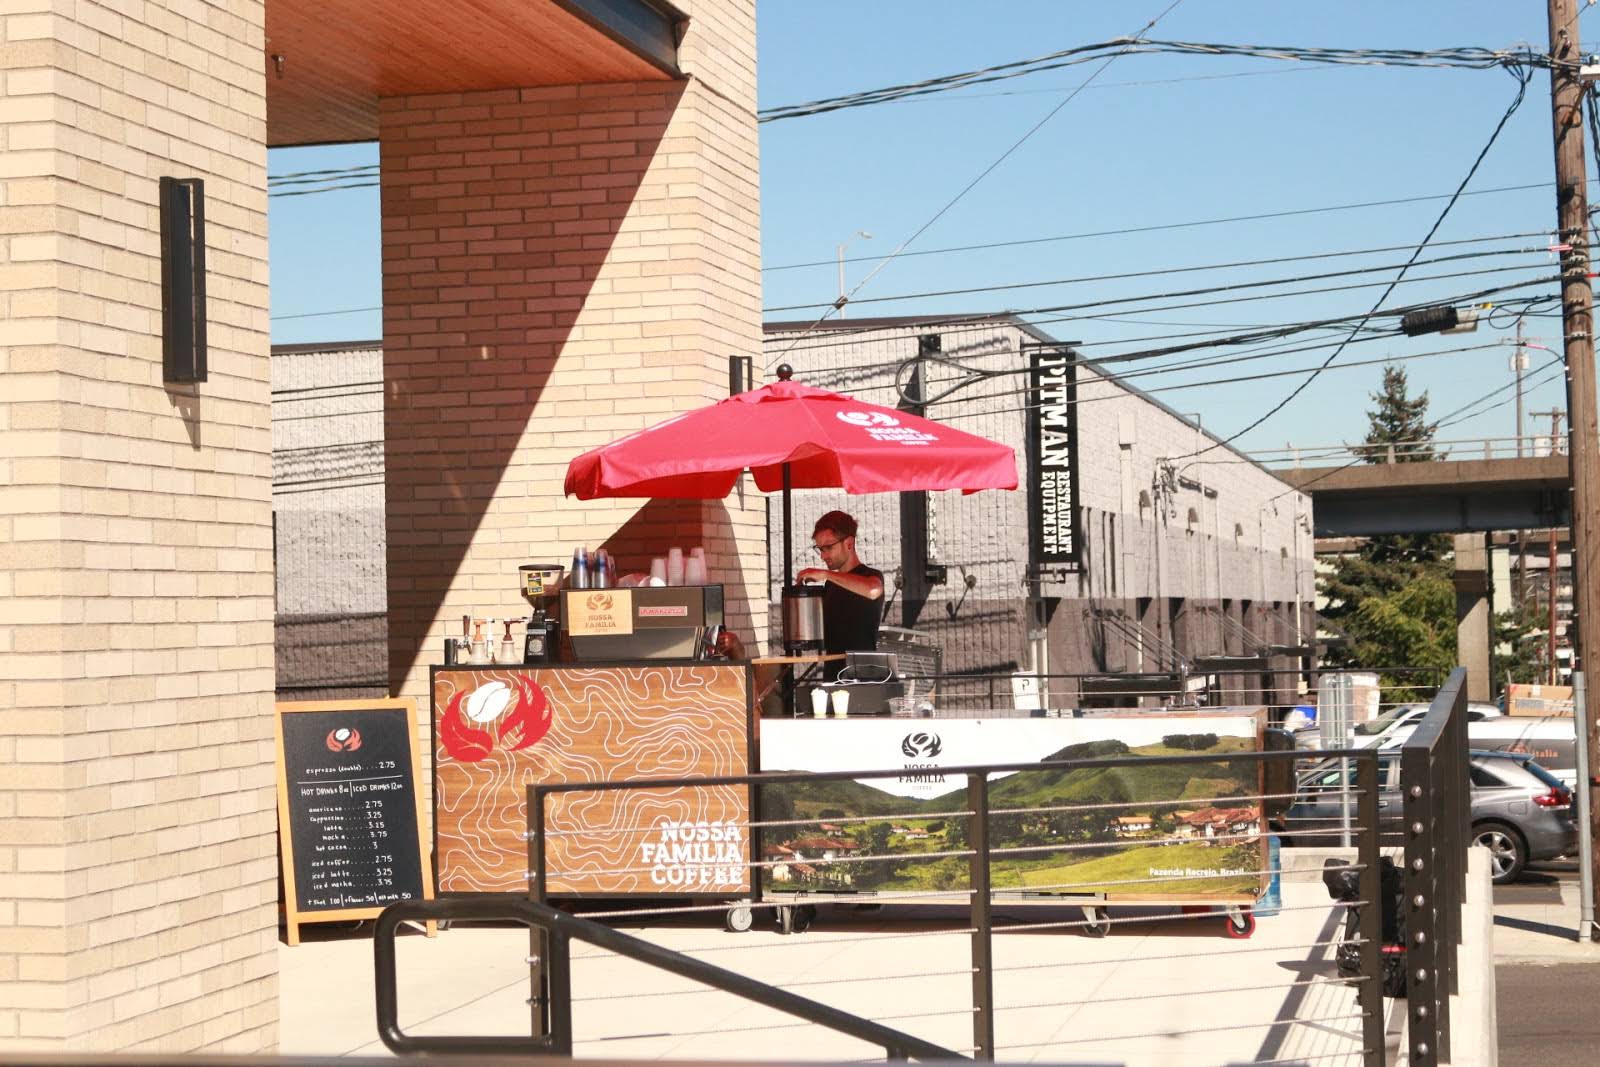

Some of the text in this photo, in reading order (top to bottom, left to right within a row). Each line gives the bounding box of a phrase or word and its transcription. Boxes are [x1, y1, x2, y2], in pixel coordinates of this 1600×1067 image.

[1039, 357, 1069, 467] PITMAN
[1040, 471, 1057, 555] EQUIPMENT
[1056, 471, 1072, 554] RESTAURANT
[305, 768, 337, 776] espresso
[379, 760, 396, 769] 2.75
[899, 773, 946, 784] FAMILIA
[300, 787, 314, 797] HOT
[352, 784, 368, 793] ICED
[365, 800, 383, 809] 2.75
[322, 830, 388, 841] mocha 3.75
[661, 821, 743, 842] NOSSA
[372, 841, 378, 850] 3
[375, 854, 393, 864] 2.75
[641, 842, 744, 864] FAMILIA
[651, 863, 743, 885] COFFEE
[1149, 867, 1184, 876] Fazenda
[1220, 867, 1245, 876] Brazil
[377, 877, 393, 887] 3.75
